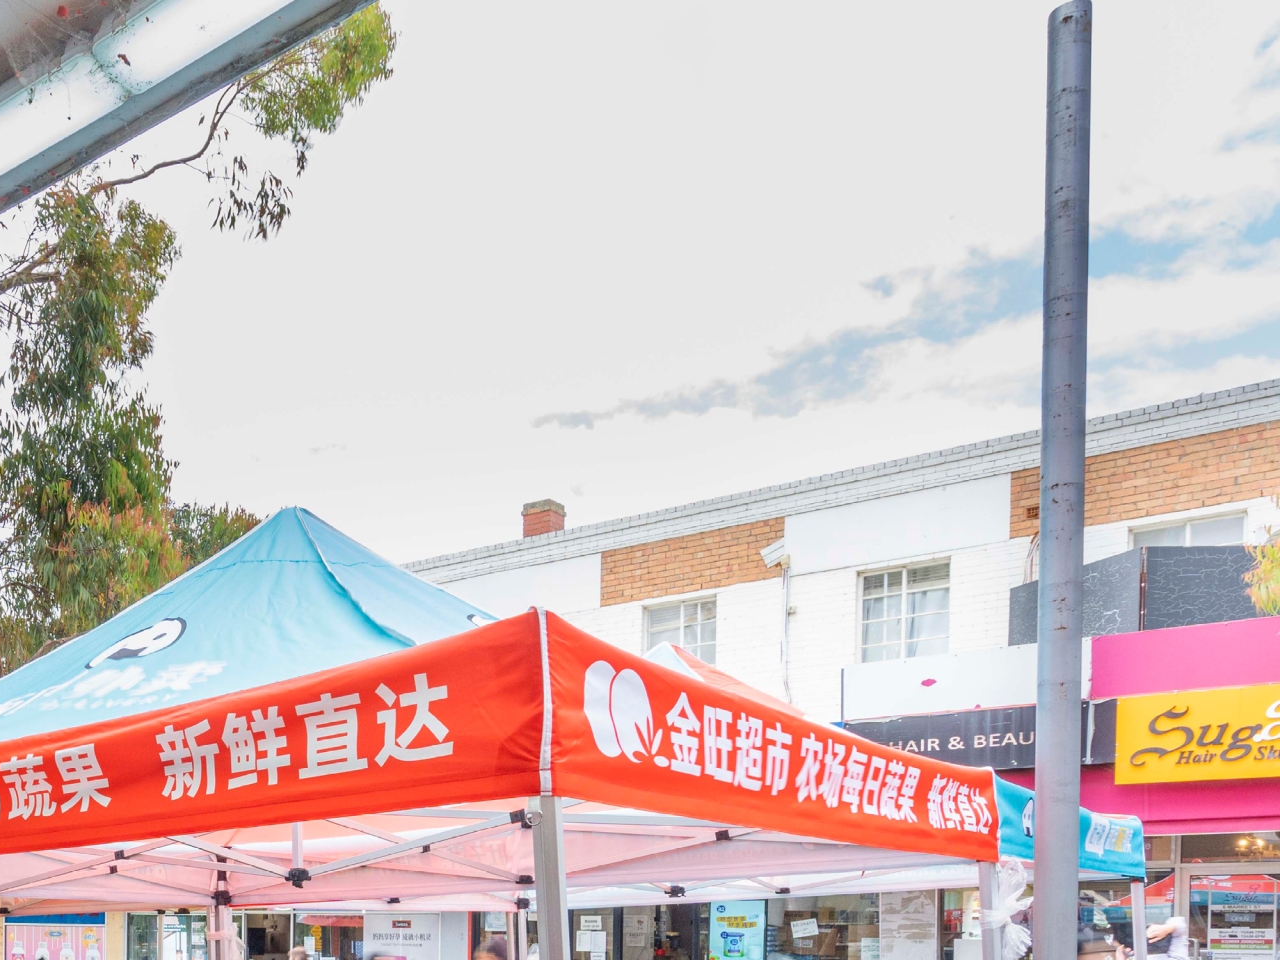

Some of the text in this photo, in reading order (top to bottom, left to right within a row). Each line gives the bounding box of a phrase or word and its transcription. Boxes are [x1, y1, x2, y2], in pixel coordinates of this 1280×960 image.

[155, 672, 454, 800] 新鲜直达
[665, 691, 993, 834] 金旺超市 农场每日蔬果 新鲜直达
[947, 736, 965, 749] &
[974, 731, 1035, 748] BEAU
[1175, 750, 1217, 765] Hair
